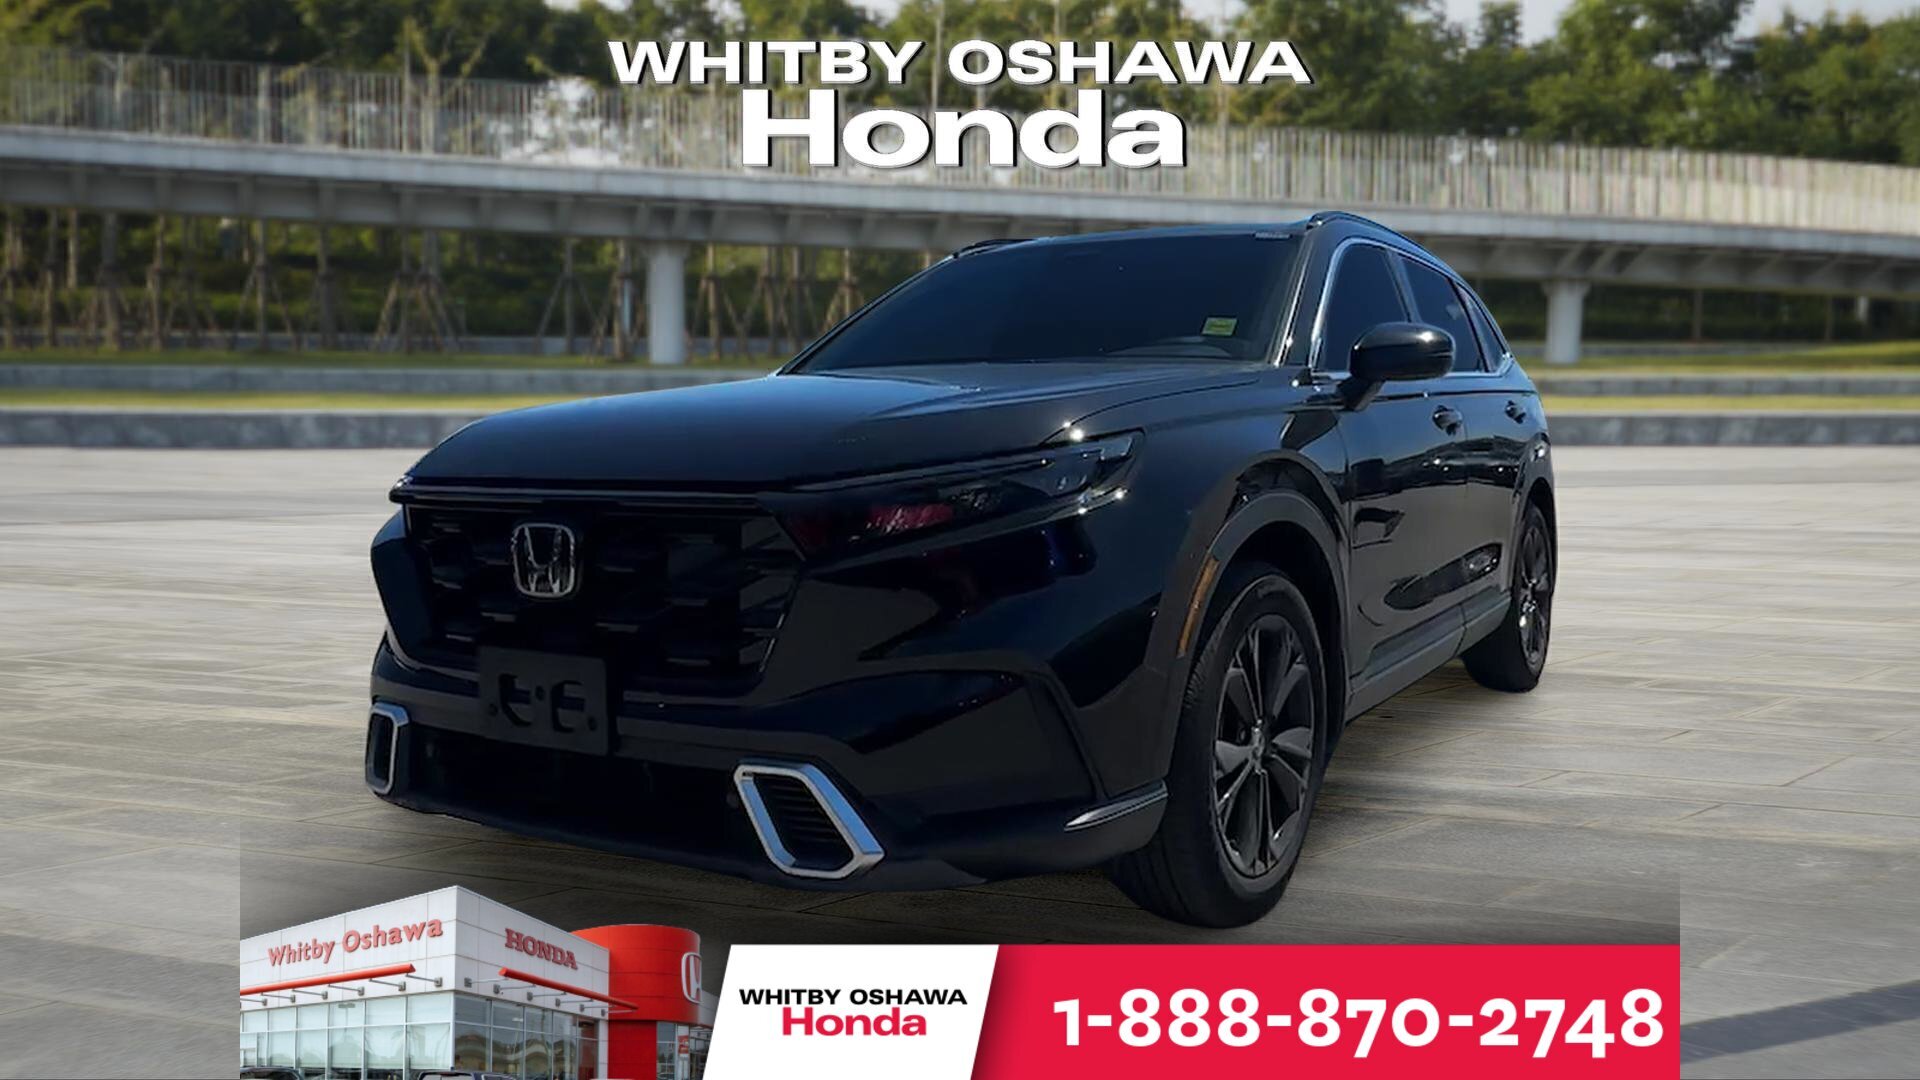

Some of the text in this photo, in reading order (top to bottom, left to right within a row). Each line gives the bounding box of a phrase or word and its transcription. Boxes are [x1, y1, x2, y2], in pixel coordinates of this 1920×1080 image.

[267, 919, 443, 967] Whitby Oshawa
[505, 928, 579, 971] HONDA
